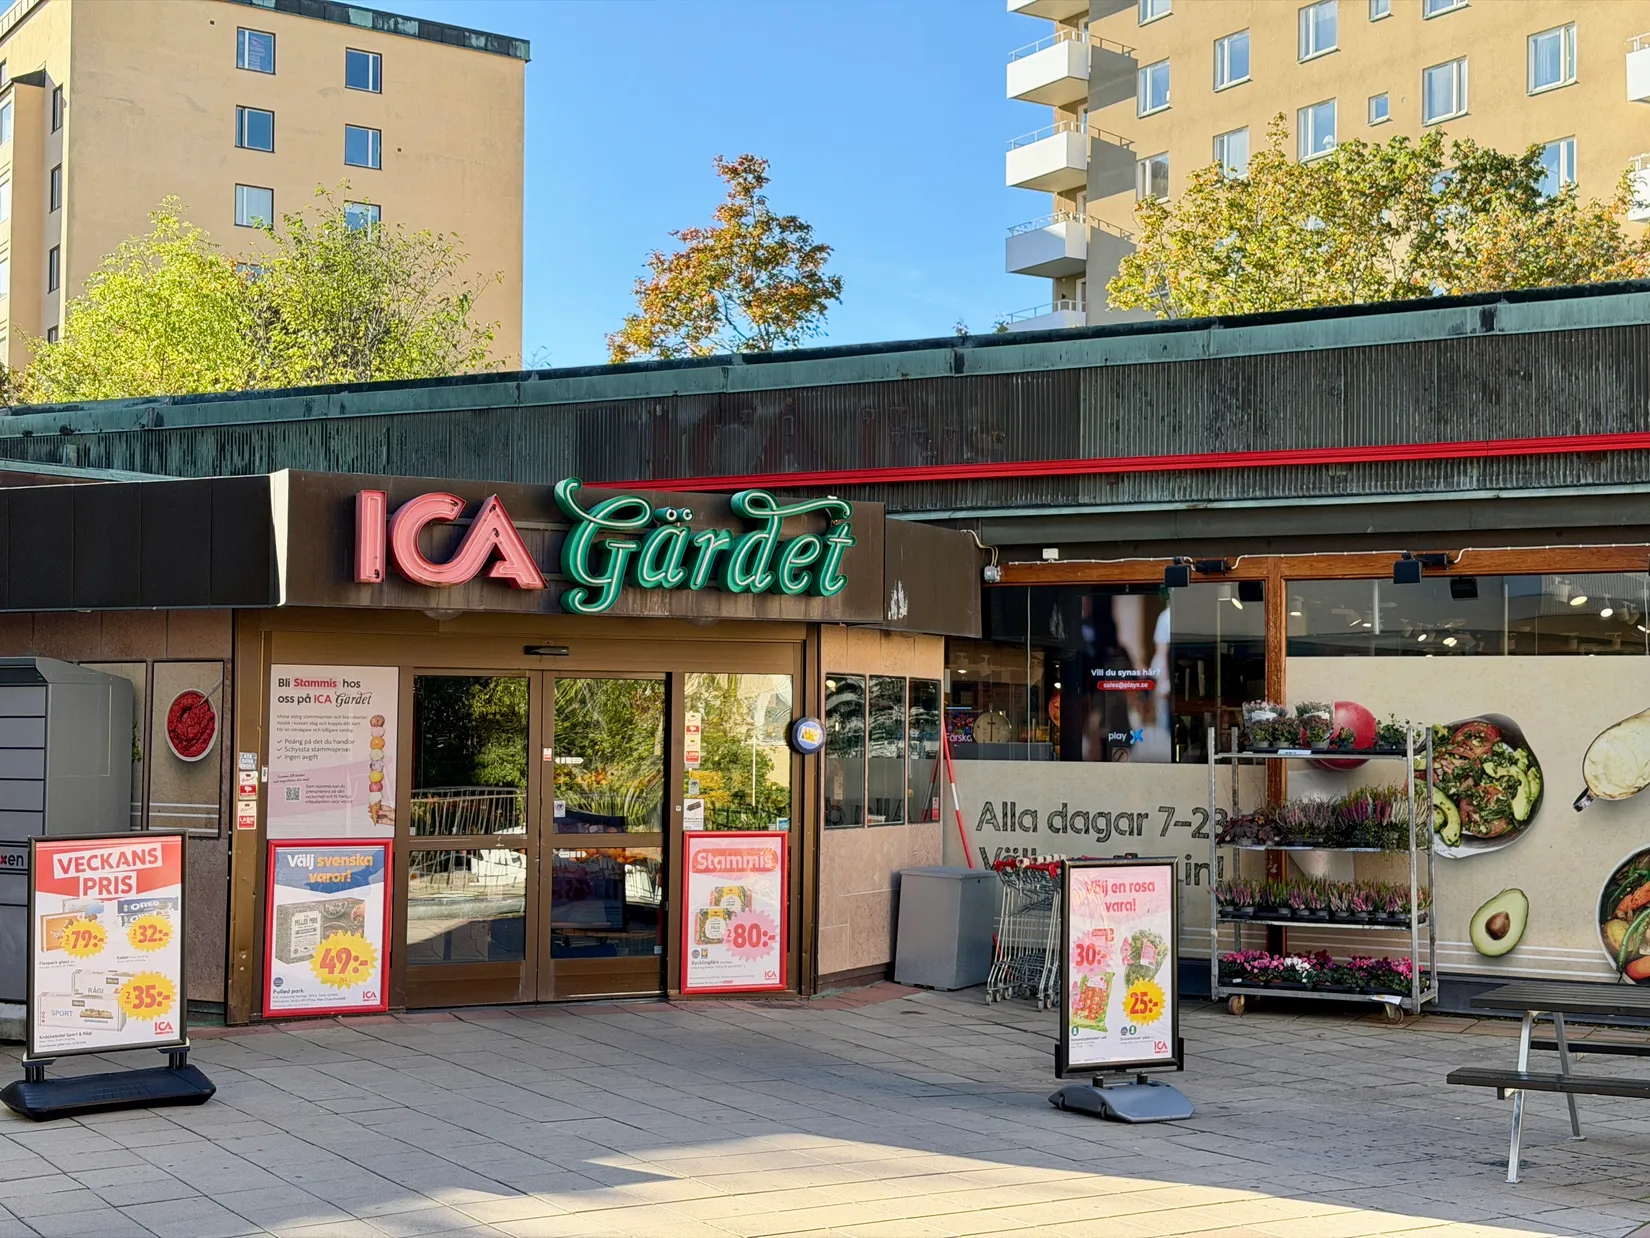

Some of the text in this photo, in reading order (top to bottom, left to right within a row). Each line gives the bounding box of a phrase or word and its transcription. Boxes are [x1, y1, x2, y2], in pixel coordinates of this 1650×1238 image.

[354, 476, 857, 615] ICA Gärdet
[278, 678, 361, 688] Bli Stammis hos
[277, 690, 373, 708] oss på ICA Gärdet
[284, 738, 303, 746] Poäng
[304, 738, 311, 746] på
[1108, 731, 1127, 742] play
[975, 801, 1038, 833] Alla
[1046, 802, 1149, 843] dagar
[56, 847, 159, 875] VECKANS
[286, 853, 374, 869] Välj svenska
[696, 852, 774, 870] Stammis
[308, 870, 351, 883] varor!
[82, 875, 133, 897] PRIS
[1111, 884, 1126, 894] en
[1129, 880, 1155, 894] rosa
[130, 901, 159, 911] OREO
[1104, 898, 1137, 913] vara!
[65, 934, 70, 942] 2
[71, 929, 105, 949] 79:-
[132, 924, 169, 943] 2 32:-
[726, 929, 732, 937] 2
[732, 922, 776, 949] 80:-
[319, 947, 368, 975] 49:-
[1076, 943, 1107, 967] 30:-
[764, 970, 777, 978] ICA
[87, 986, 104, 994] RÅGI
[125, 984, 171, 1009] 2 35:-
[362, 990, 377, 999] ICA
[1130, 991, 1159, 1015] 25:-
[51, 1009, 73, 1018] SPORT
[154, 1021, 173, 1032] ICA
[1154, 1040, 1168, 1051] ICA
